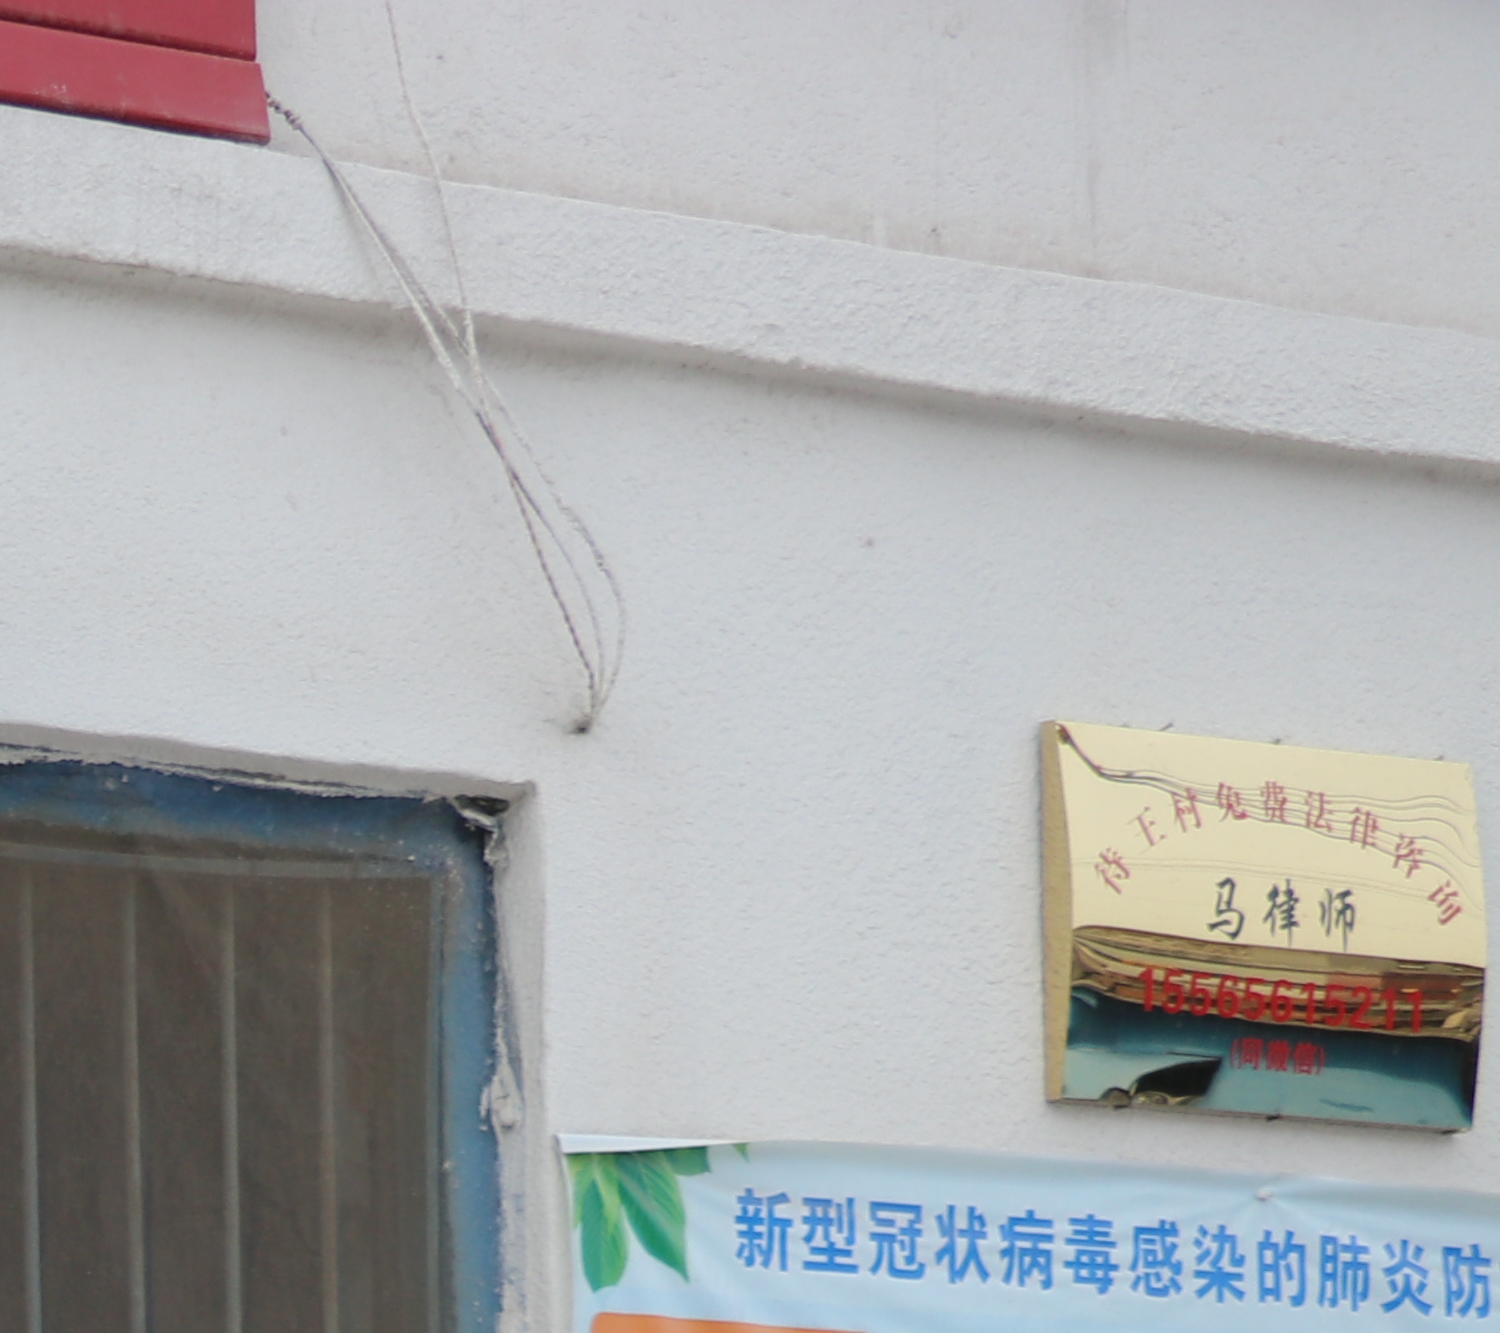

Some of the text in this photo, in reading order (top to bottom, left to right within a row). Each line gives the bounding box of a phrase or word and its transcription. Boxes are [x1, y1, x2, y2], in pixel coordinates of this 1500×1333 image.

[1206, 878, 1357, 952] 马律师
[1138, 965, 1423, 1032] 15565615211
[734, 1187, 1493, 1320] 新型冠状病毒感染的肺炎防
